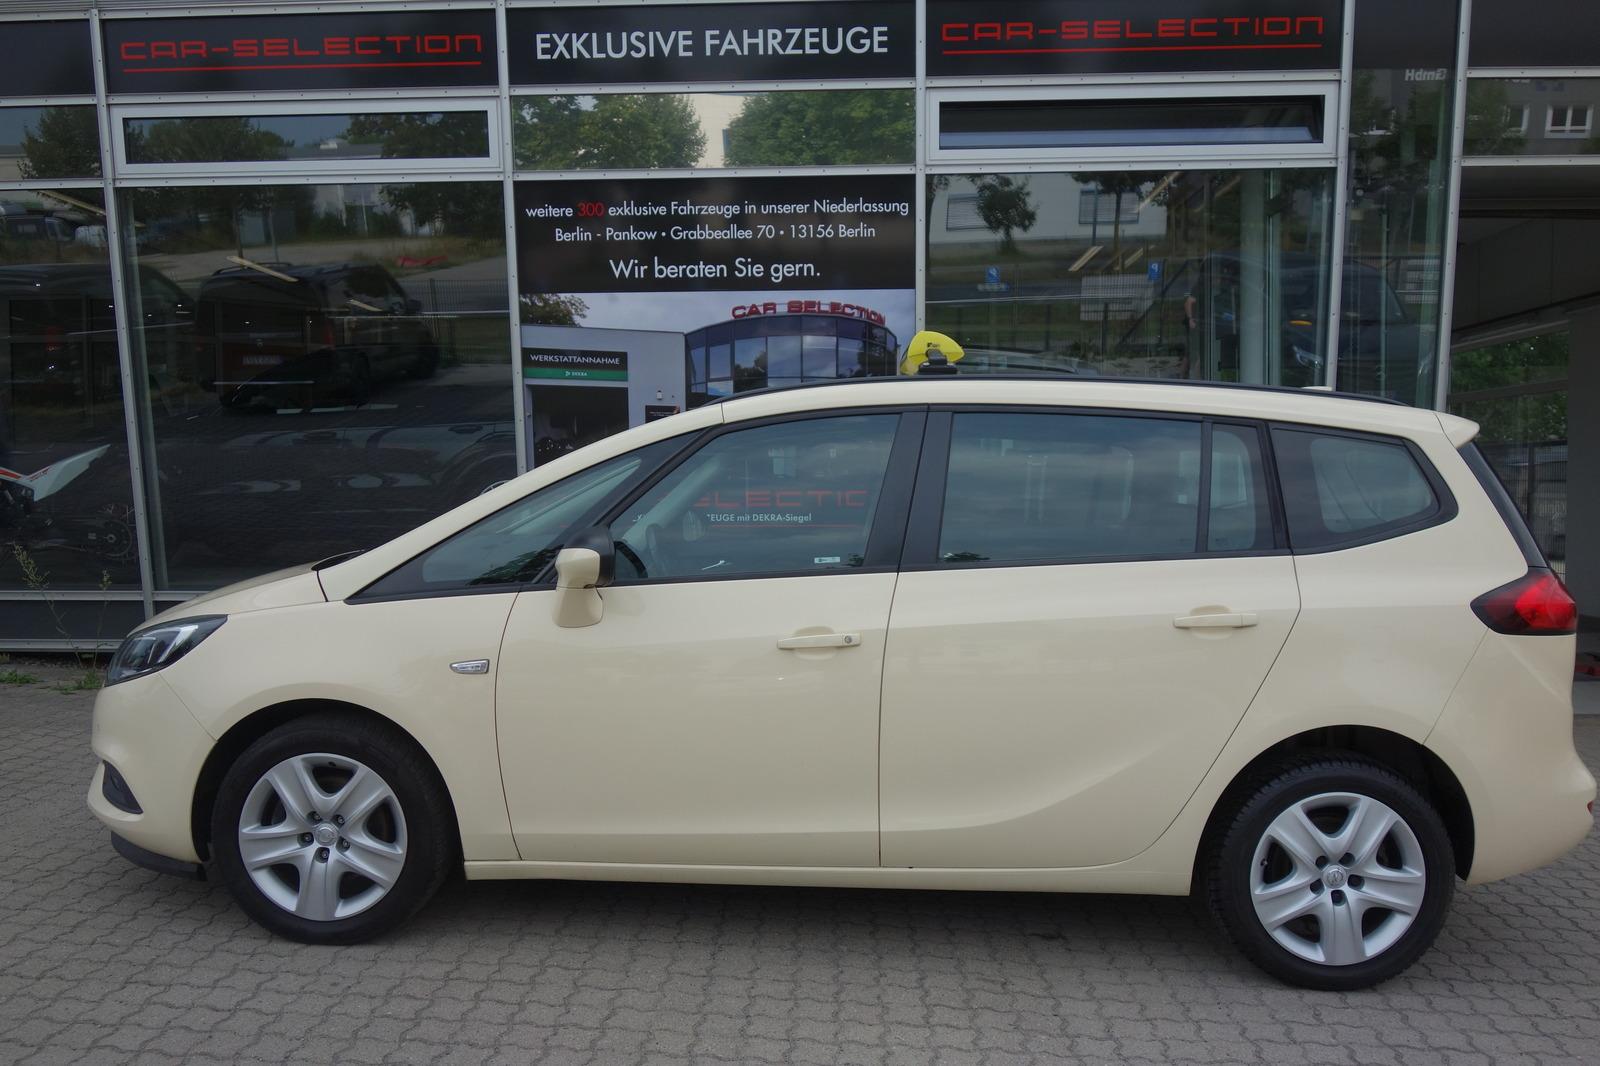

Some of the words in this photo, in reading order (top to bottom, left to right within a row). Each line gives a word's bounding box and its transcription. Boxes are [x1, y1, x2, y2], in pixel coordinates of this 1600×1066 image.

[941, 16, 1324, 42] CAR-SELECTION
[120, 34, 482, 61] CAR-SELECTION
[536, 31, 693, 60] EXKLUSIVE
[705, 26, 888, 57] FAHRZEUGE
[525, 204, 573, 218] weitere
[577, 202, 605, 218] 300
[608, 201, 667, 217] exklusive
[670, 200, 741, 220] Fahrzeuge
[744, 201, 757, 215] in
[761, 203, 810, 215] unserer
[813, 198, 909, 217] Niederlassung
[555, 227, 592, 242] Berlin
[606, 226, 658, 241] Pankow
[670, 224, 753, 240] Grabbeallee
[757, 224, 775, 239] 70
[790, 224, 835, 239] 13156
[838, 223, 876, 239] Berlin
[610, 259, 648, 279] Wir
[654, 257, 728, 279] beraten
[734, 257, 765, 278] Sie
[770, 262, 822, 283] gern.
[731, 302, 777, 319] CAR
[787, 300, 886, 326] SELECTION
[530, 354, 621, 365] WERKSTATTANNAHME
[736, 513, 750, 522] mit
[752, 513, 812, 524] DEKRA-Siegel
